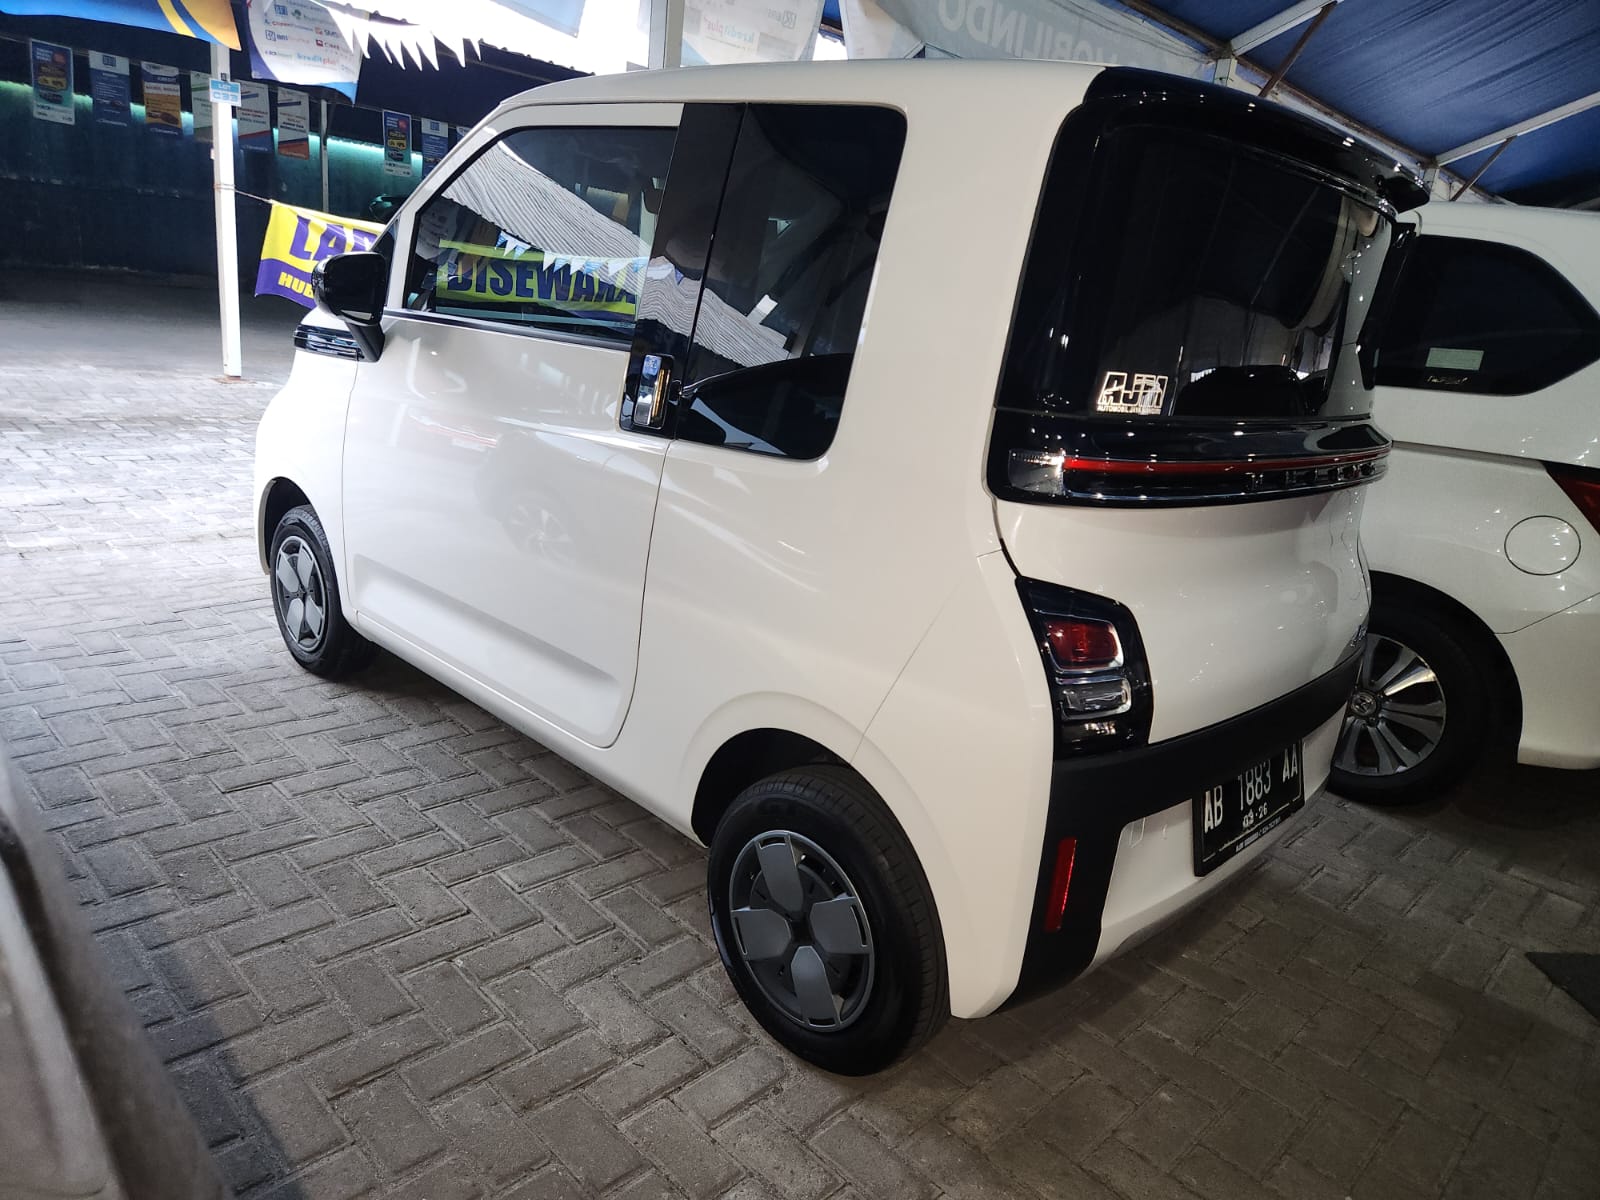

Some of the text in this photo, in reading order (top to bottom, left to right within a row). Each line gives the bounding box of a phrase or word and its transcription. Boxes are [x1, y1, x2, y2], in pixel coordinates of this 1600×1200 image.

[1204, 744, 1298, 834] AB 1883 AA
